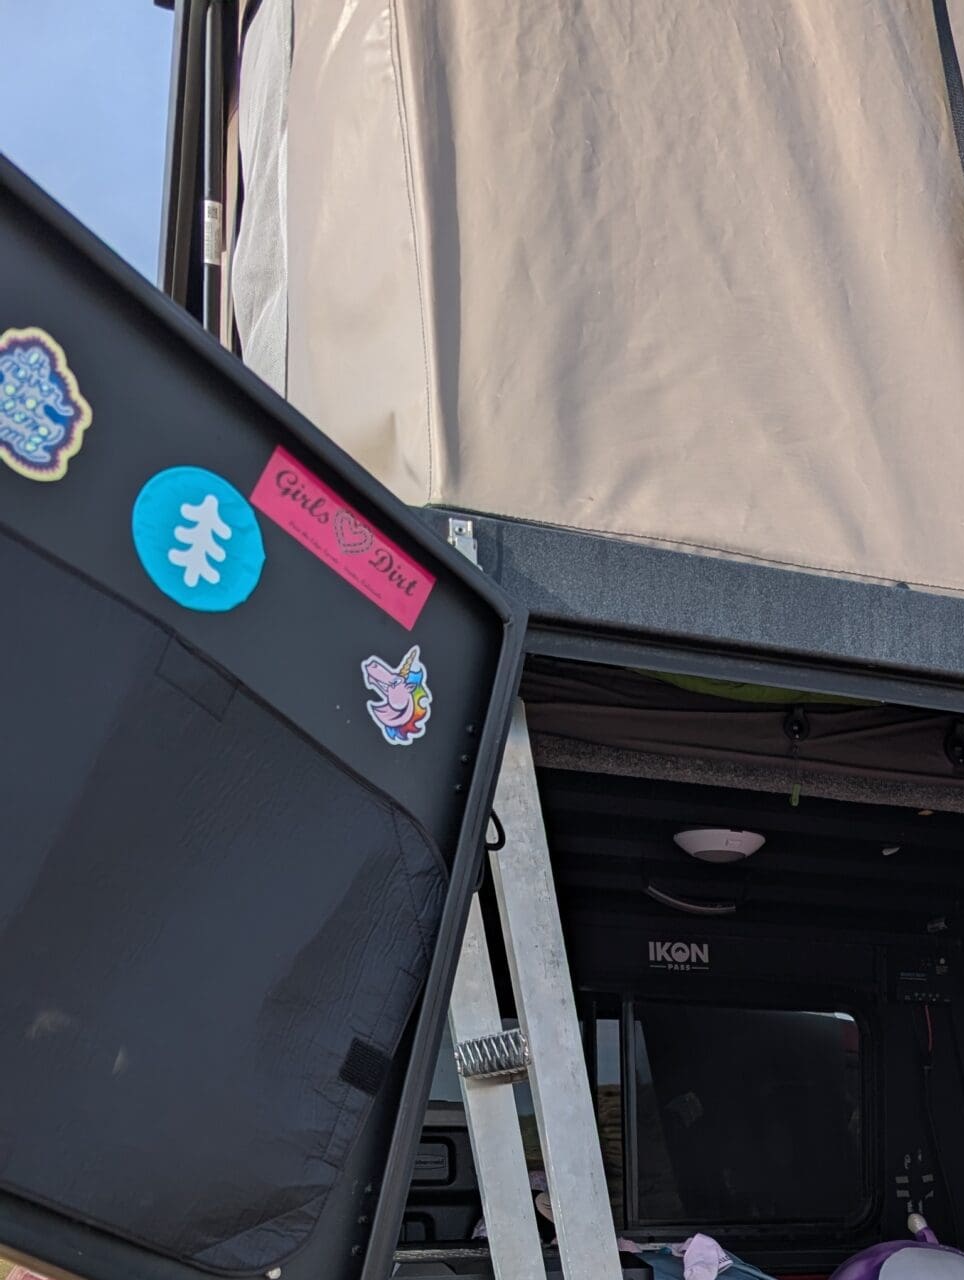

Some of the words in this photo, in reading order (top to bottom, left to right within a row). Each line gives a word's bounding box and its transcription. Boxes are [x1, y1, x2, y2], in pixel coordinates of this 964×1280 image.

[275, 470, 330, 525] Girls
[368, 548, 418, 597] Dirt
[648, 941, 709, 963] IKON
